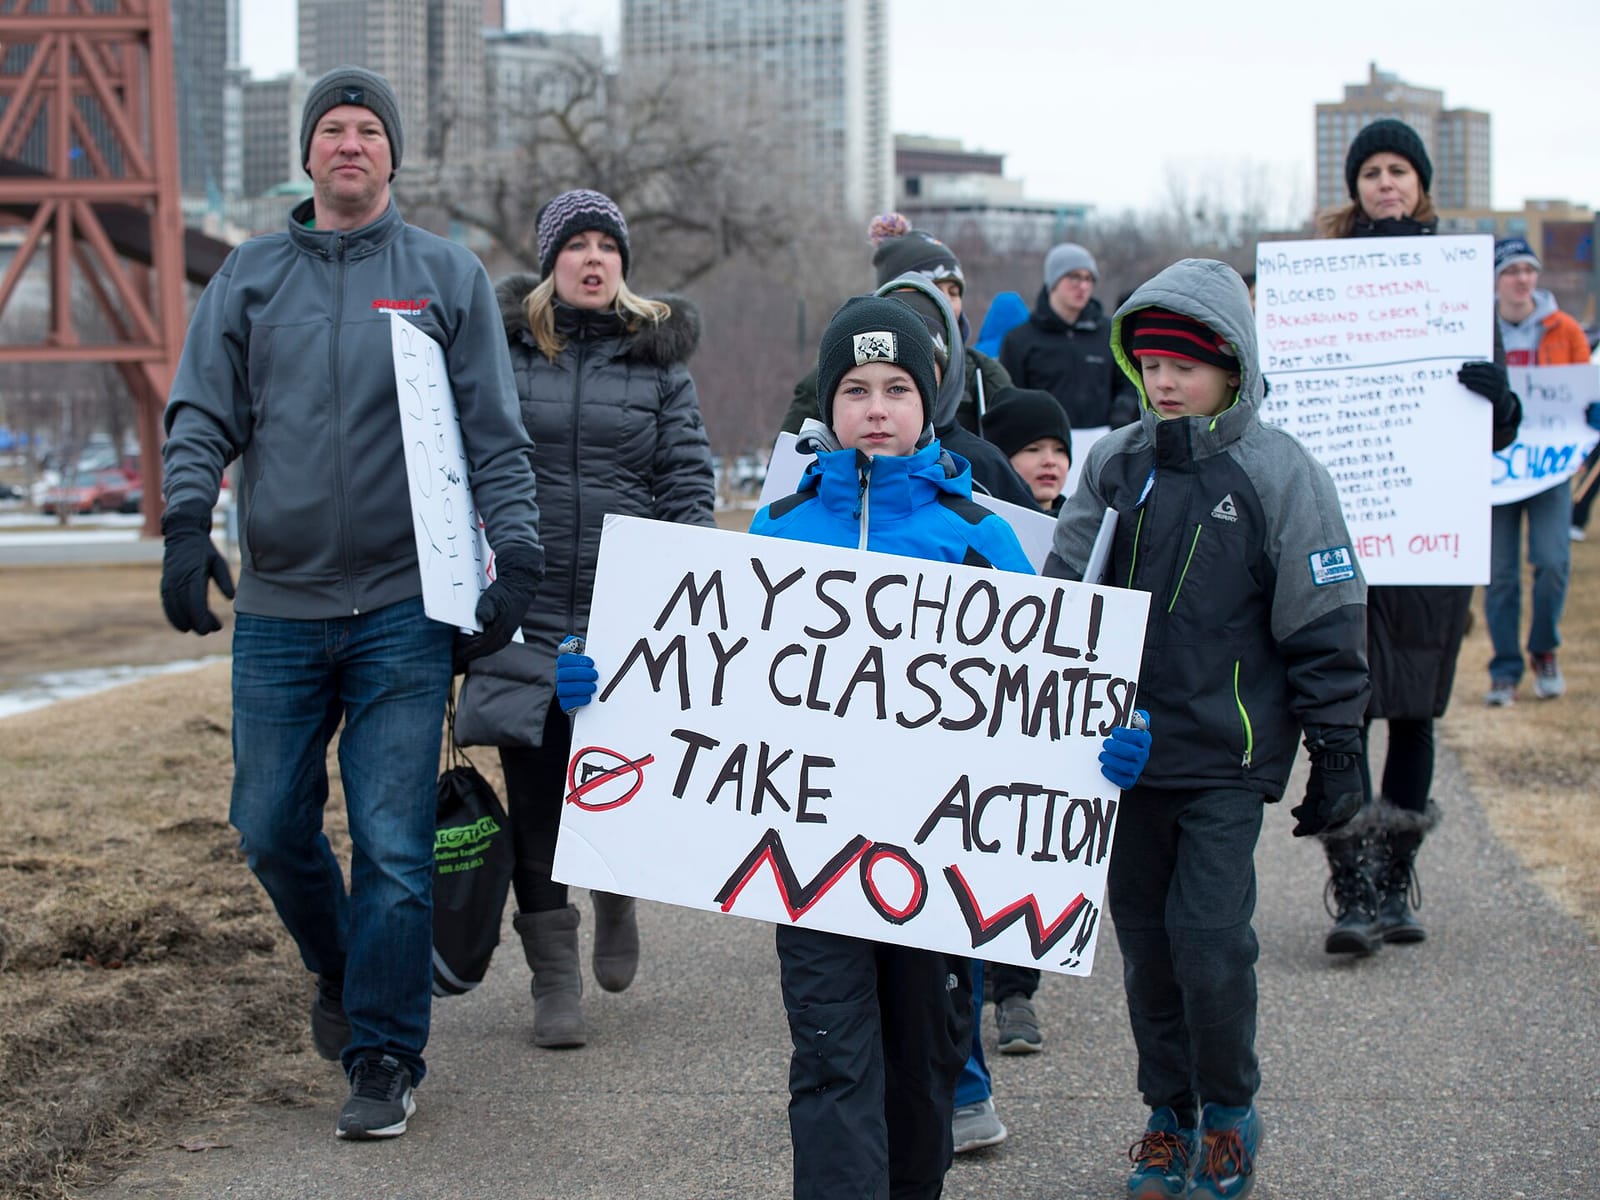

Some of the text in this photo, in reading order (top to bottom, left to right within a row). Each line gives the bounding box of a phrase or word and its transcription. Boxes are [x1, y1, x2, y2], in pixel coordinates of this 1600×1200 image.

[1440, 248, 1477, 263] WHO
[1266, 280, 1440, 306] BLOCKED CRIMINAL
[1266, 311, 1358, 329] BACKGROUND
[1368, 306, 1419, 322] CHECKS
[1267, 335, 1337, 352] VIOLENCE
[1347, 326, 1428, 346] PREVENTION
[1269, 355, 1302, 368] PAST
[401, 328, 442, 570] YOUR
[425, 346, 463, 600] THOUGHTS
[1354, 533, 1459, 559] HEM OUT!
[654, 558, 1104, 661] MY SCHOOL!
[599, 632, 1135, 741] MY CLASSMATES!
[671, 729, 1117, 866] TAKE ACTION
